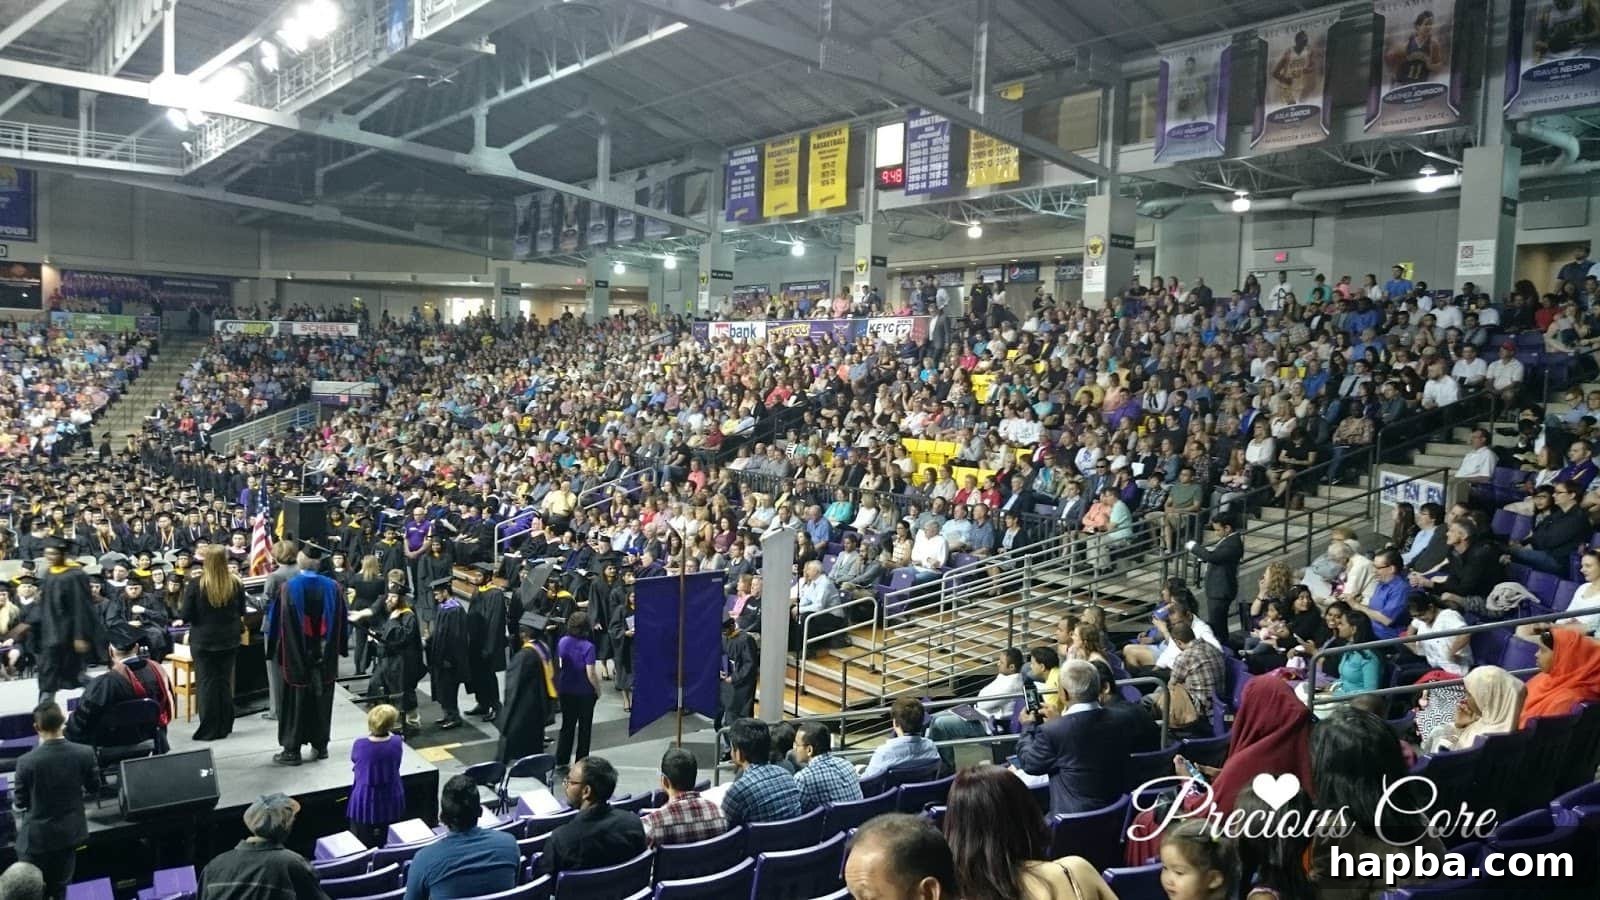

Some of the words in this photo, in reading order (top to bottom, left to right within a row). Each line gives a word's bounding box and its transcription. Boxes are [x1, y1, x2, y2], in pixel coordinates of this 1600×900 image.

[1560, 62, 1591, 73] NELSON
[812, 137, 846, 150] BASKETBALL
[300, 324, 349, 333] SCHEELS
[869, 321, 895, 334] KEYC
